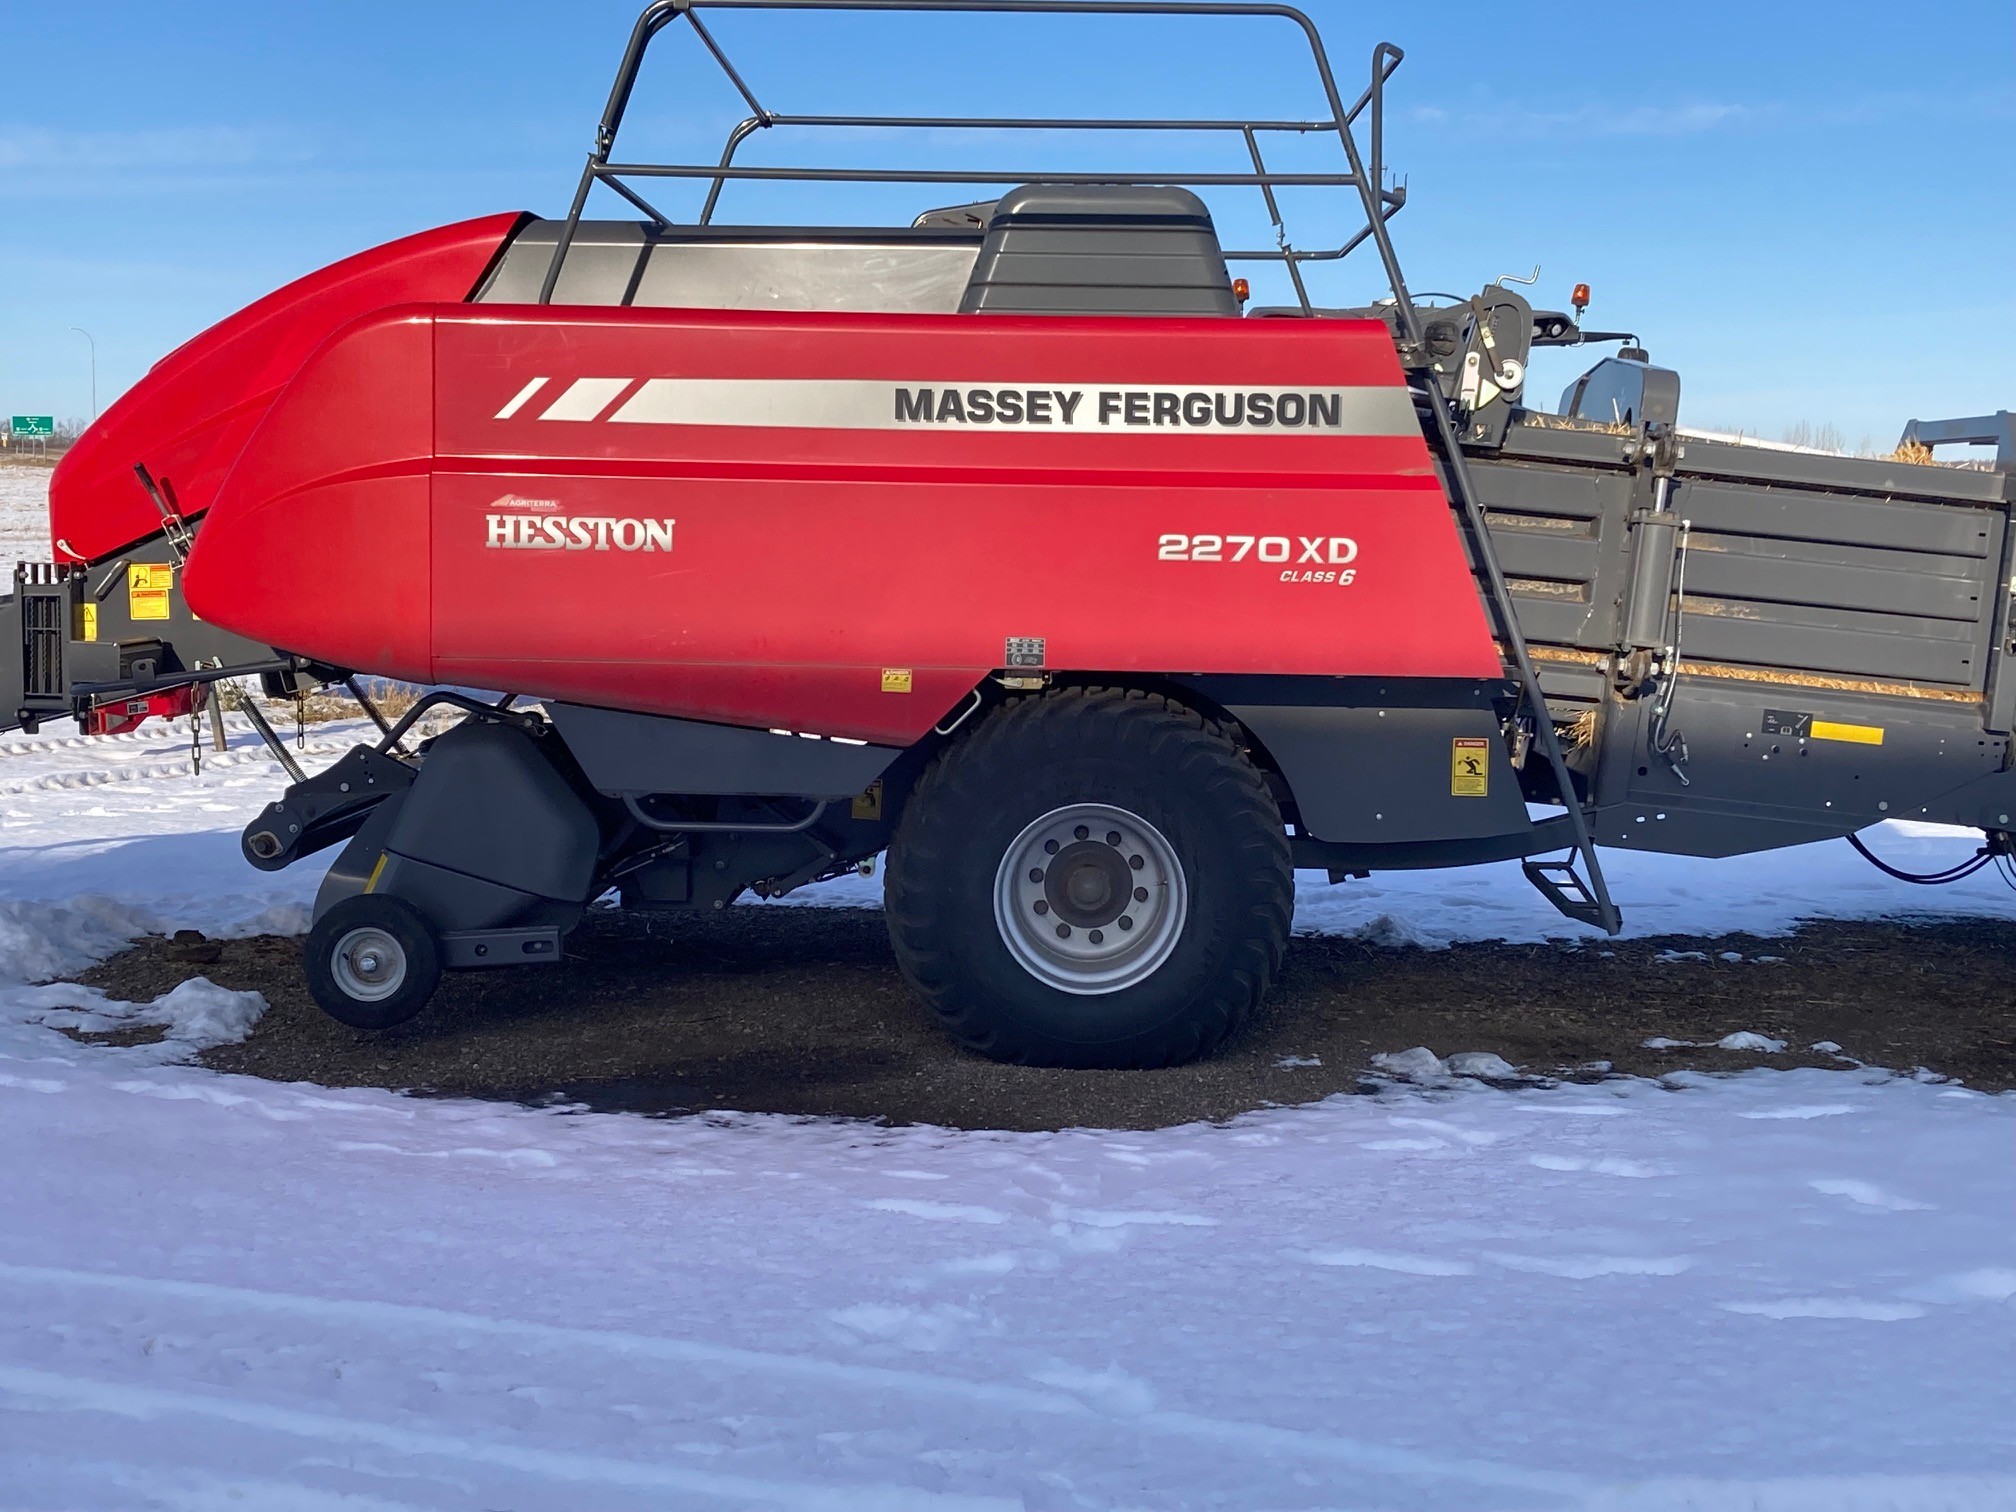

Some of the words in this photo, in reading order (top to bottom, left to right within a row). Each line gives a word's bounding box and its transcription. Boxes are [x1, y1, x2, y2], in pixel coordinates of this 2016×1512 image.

[894, 387, 1082, 425] MASSEY
[1098, 391, 1342, 428] FERGUSON
[509, 499, 557, 508] AGRITERRA
[485, 514, 676, 552] HESSTON
[1157, 533, 1291, 563] 2270
[1296, 536, 1358, 564] XD
[1279, 570, 1337, 583] CLASS
[1338, 569, 1357, 586] 6
